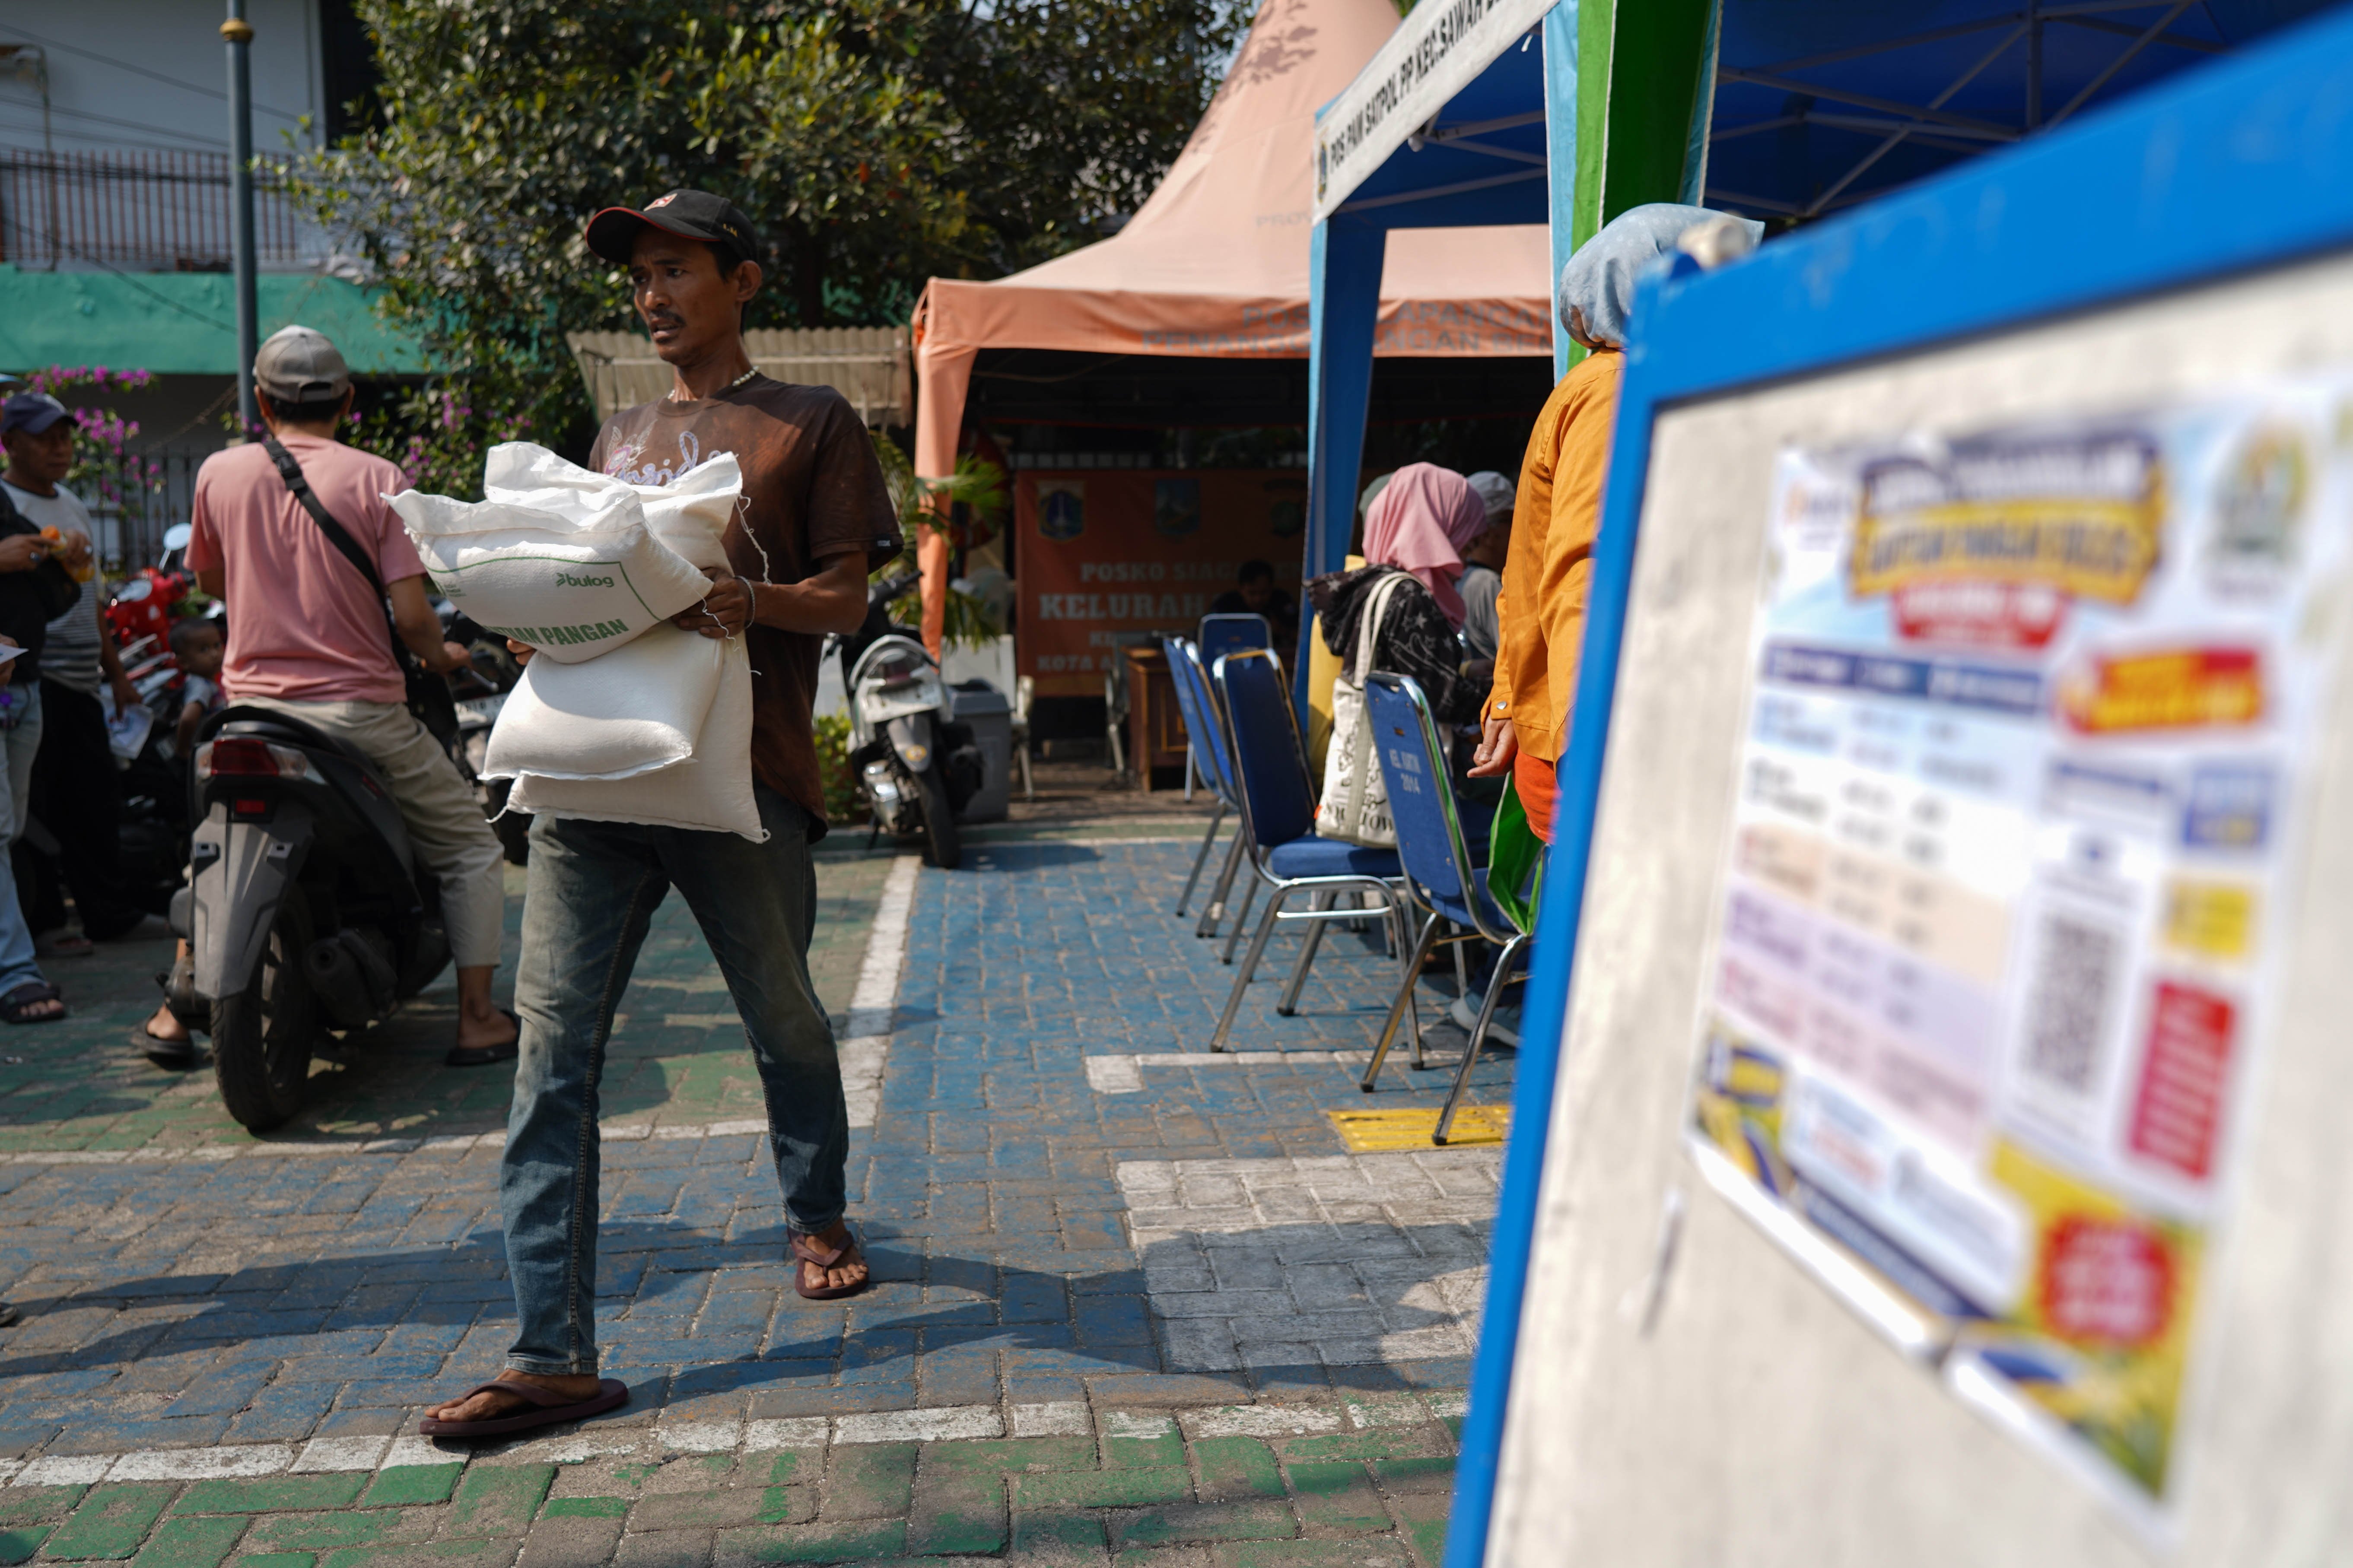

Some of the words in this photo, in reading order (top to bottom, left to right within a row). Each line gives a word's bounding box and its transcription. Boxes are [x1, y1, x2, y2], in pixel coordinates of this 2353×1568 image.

[1330, 131, 1345, 174] POS
[565, 573, 614, 587] bulog
[1081, 562, 1166, 583] POSKO
[1038, 593, 1218, 620] KELURAH
[539, 618, 630, 645] PANGAN
[1037, 654, 1094, 671] KOTA
